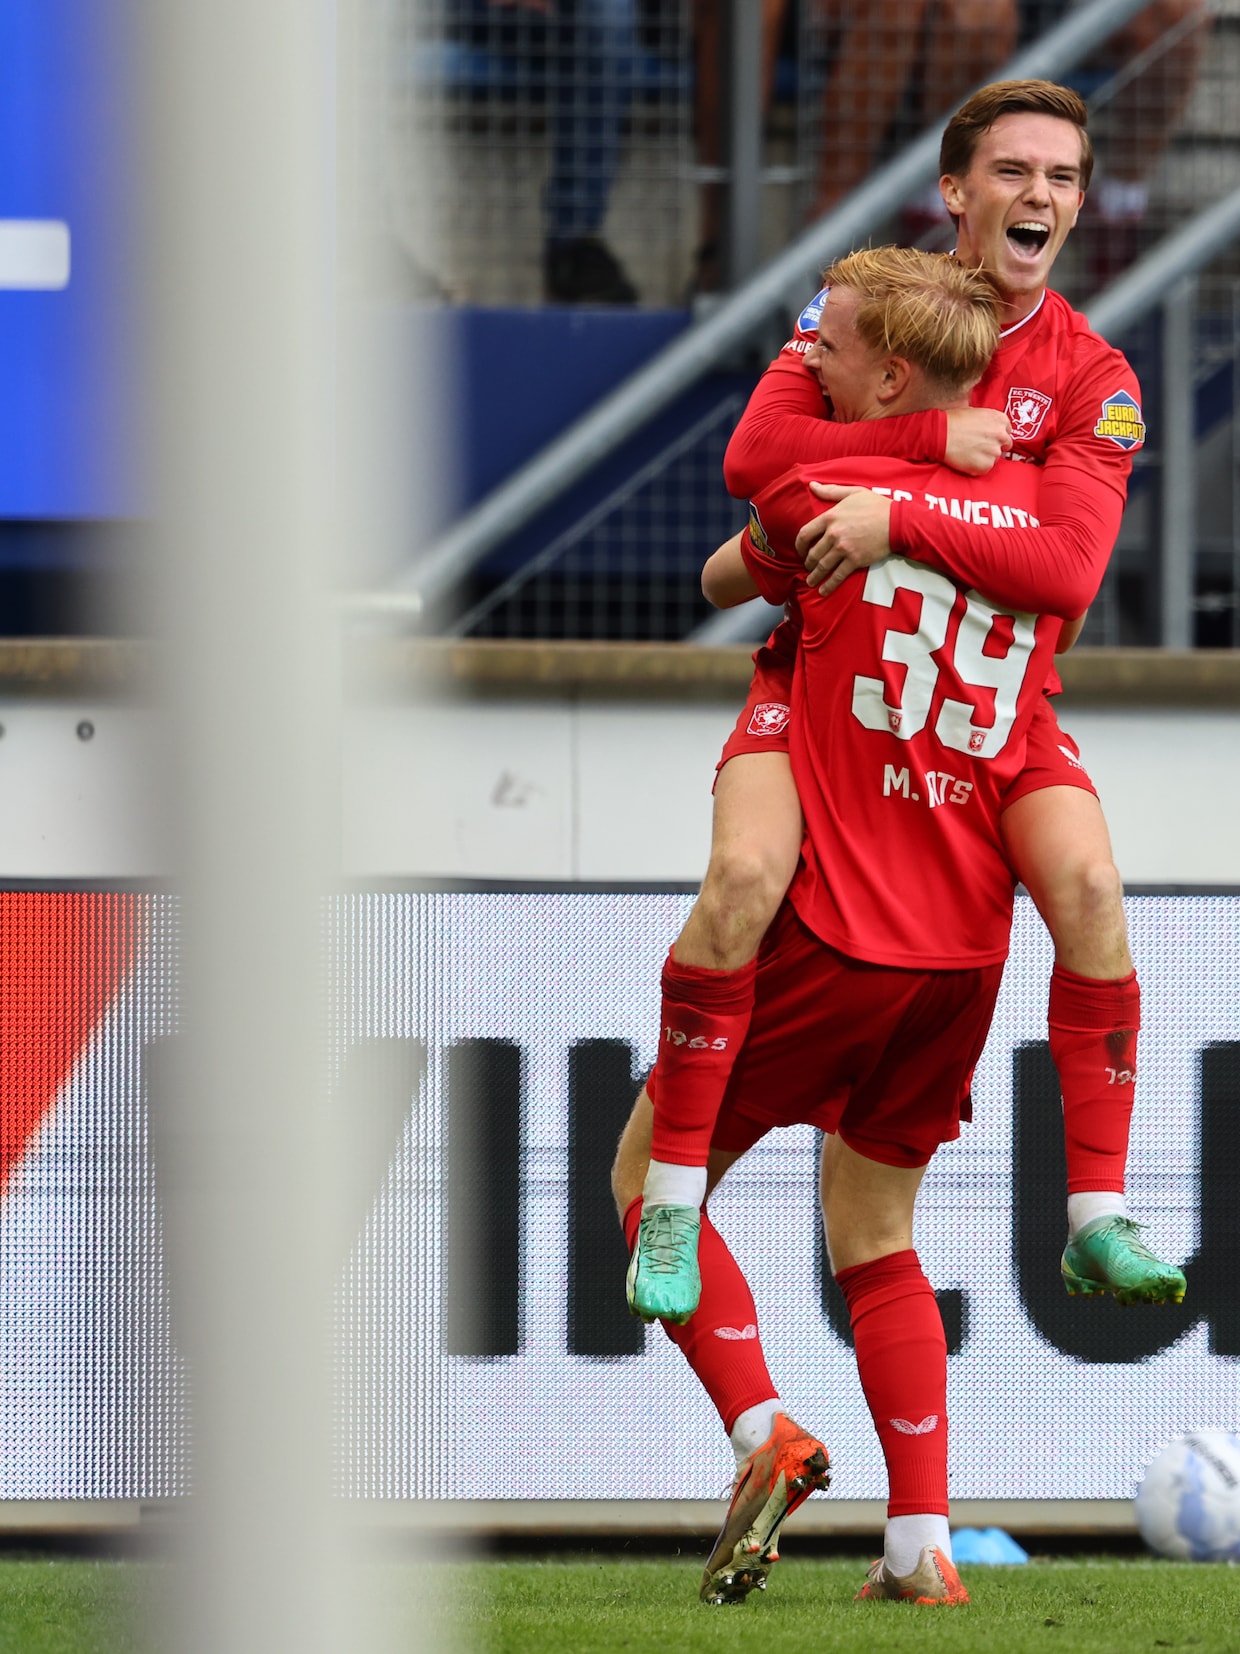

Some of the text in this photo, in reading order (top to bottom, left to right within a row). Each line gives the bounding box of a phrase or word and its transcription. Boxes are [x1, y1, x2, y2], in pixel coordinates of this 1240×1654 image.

[1107, 405, 1135, 422] EURO
[1096, 419, 1144, 441] JACKPOT
[852, 554, 1039, 759] 39
[883, 764, 919, 801] M.
[664, 1026, 728, 1050] 1965
